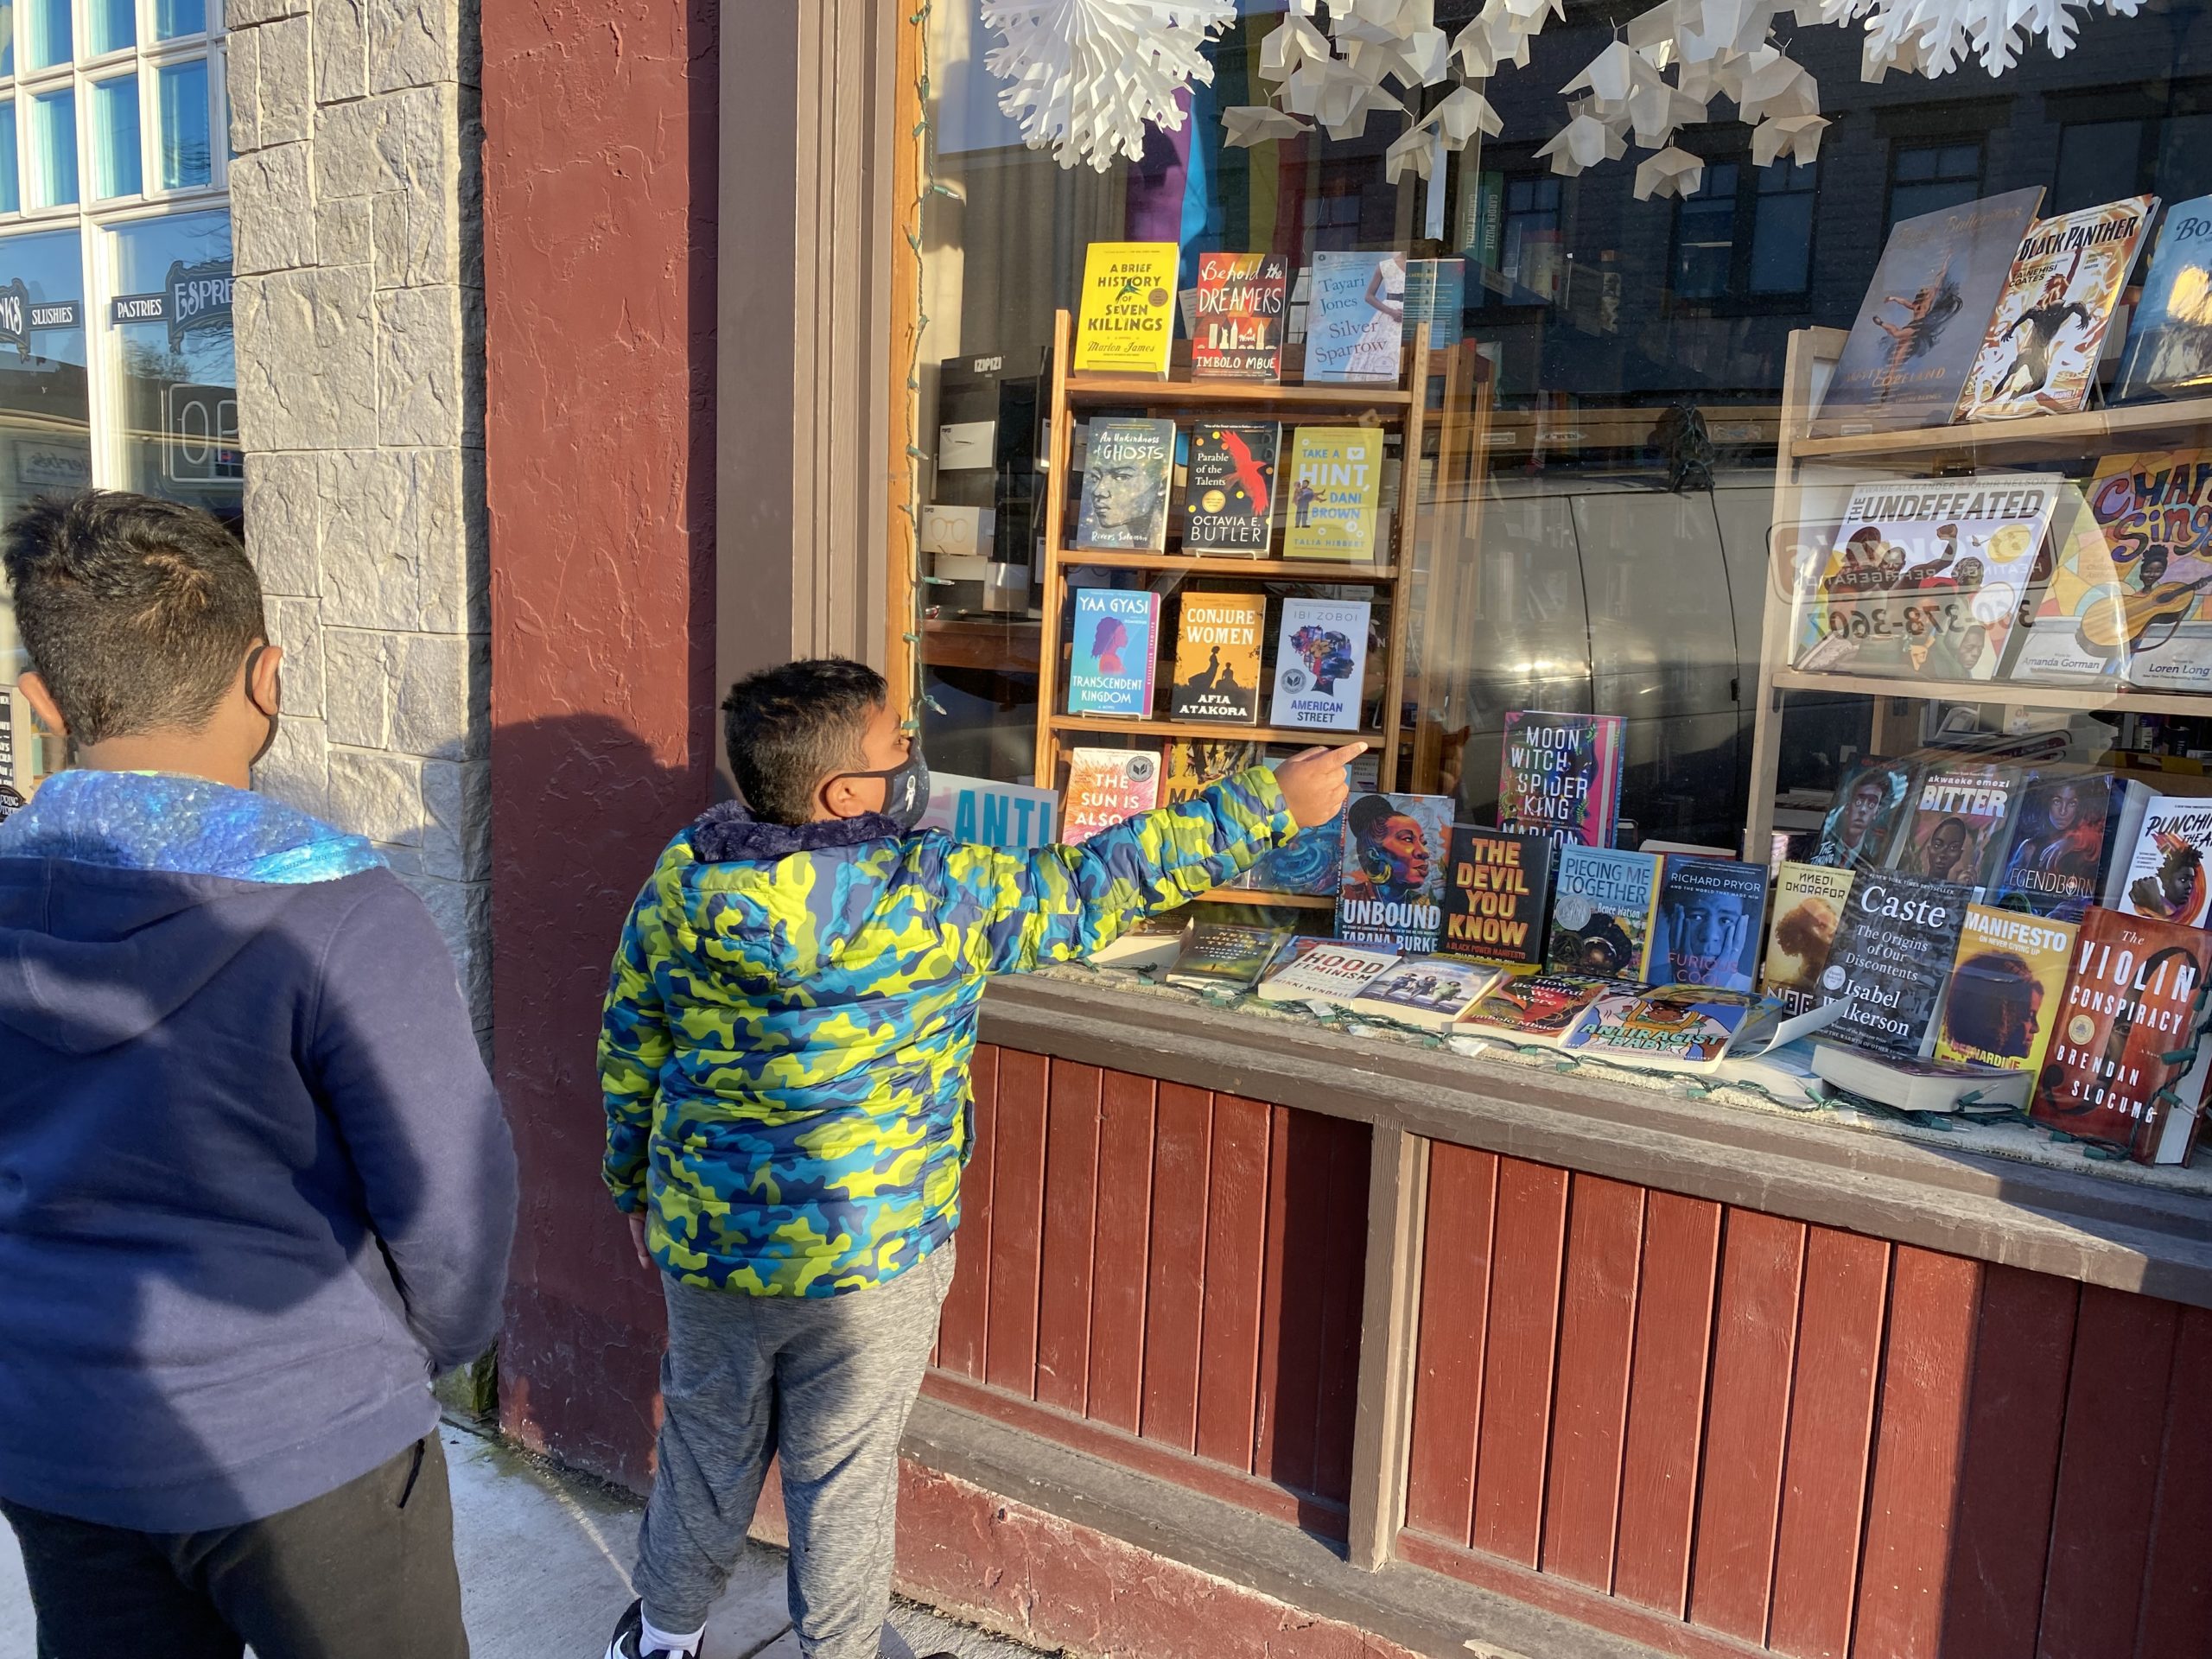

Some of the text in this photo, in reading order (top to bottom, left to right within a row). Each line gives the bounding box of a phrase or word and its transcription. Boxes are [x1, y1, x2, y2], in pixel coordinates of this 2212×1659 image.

[2018, 216, 2139, 262] BLACK PANTHER
[1110, 264, 1153, 273] A BRIEF
[1202, 257, 1282, 283] Behold the
[1097, 276, 1161, 287] HISTORY
[1319, 273, 1365, 295] Tayari
[2009, 274, 2045, 288] COATES
[117, 298, 162, 319] PASTRIES
[1198, 286, 1282, 315] DREAMERS
[1320, 297, 1358, 317] Jones
[32, 307, 73, 325] SLUSHIES
[1106, 304, 1147, 315] SEVEN
[1088, 318, 1163, 331] KILLINGS
[1329, 320, 1378, 339] Silver
[1087, 340, 1154, 353] Marlon James
[1315, 340, 1388, 366] Sparrow
[974, 356, 1002, 373] IZIPIZI
[1197, 356, 1276, 370] IMBOLO MBUE
[1099, 432, 1160, 443] An Unkindness
[1103, 444, 1164, 461] GHOSTS
[1197, 453, 1229, 462] Parable
[1302, 449, 1340, 458] TAKE A
[1196, 465, 1222, 474] of the
[1299, 463, 1370, 492] HINT,
[1195, 477, 1226, 486] Talents
[1896, 482, 1955, 493] ALEXANDER
[2004, 478, 2049, 487] NELSON
[1330, 493, 1362, 504] DANI
[1860, 489, 2044, 524] UNDEFEATED
[1312, 507, 1360, 519] BROWN
[1847, 498, 1866, 524] THE
[1192, 516, 1261, 527] OCTAVIA E.
[1191, 526, 1261, 542] BUTLER
[1080, 596, 1148, 614] YAA GYASI
[1187, 608, 1255, 625] CONJURE
[1294, 611, 1358, 622] IBI ZOBOI
[1186, 626, 1255, 645] WOMEN
[2023, 657, 2100, 670] Amanda Gorman
[2149, 664, 2179, 673] Loren
[2183, 664, 2211, 677] Long
[1073, 676, 1142, 690] TRANSCENDENT
[1081, 690, 1131, 703] KINGDOM
[1198, 694, 1230, 704] AFIA
[1179, 705, 1248, 716] ATAKORA
[1291, 700, 1343, 713] AMERICAN
[1297, 712, 1335, 723] STREET
[1526, 726, 1580, 750] MOON
[1511, 747, 1567, 772] WITCH
[1095, 774, 1129, 789] THE
[1517, 772, 1588, 799] SPIDER
[1081, 792, 1140, 810] SUN IS
[1524, 795, 1569, 820] KING
[1919, 785, 2008, 818] BITTER
[954, 789, 1052, 848] ANTI
[1074, 813, 1122, 827] ALSO
[2183, 833, 2203, 844] THE
[1471, 837, 1522, 868] THE
[1819, 841, 1835, 855] THE
[1456, 861, 1529, 895] DEVIL
[1566, 858, 1650, 886] PIECING ME
[1565, 874, 1647, 904] TOGETHER
[1671, 873, 1761, 892] RICHARD PRYOR
[1785, 881, 1846, 899] OKORAFOR
[1920, 883, 1955, 895] BESTSELLER
[1465, 889, 1516, 919] YOU
[1618, 905, 1641, 918] Watson
[1861, 886, 1946, 928] Caste
[1343, 899, 1441, 930] UNBOUND
[1447, 913, 1529, 948] KNOW
[1857, 925, 1929, 951] The Origins
[1964, 912, 2068, 952] MANIFESTO
[2122, 930, 2145, 945] The
[1207, 940, 1252, 949] TYSON
[1396, 935, 1439, 952] BURKE
[1452, 942, 1471, 951] BLACK
[1471, 945, 1492, 955] POWER
[1492, 947, 1526, 959] MANIFESTO
[1988, 938, 2007, 948] NEVER
[2008, 943, 2030, 954] GIVING
[1867, 944, 1908, 963] of Our
[1302, 952, 1384, 974] HOOD
[1669, 952, 1738, 974] FURIOUS
[1846, 952, 1919, 982] Discontents
[2079, 940, 2196, 1003] VIOLIN
[1294, 963, 1372, 982] FEMINISM
[1512, 982, 1585, 996] Beautiful
[1535, 978, 1568, 988] How
[1516, 994, 1557, 1006] Were
[1531, 990, 1554, 999] We
[1844, 979, 1901, 1008] Isabel
[2069, 985, 2183, 1035] CONSPIRACY
[1519, 1019, 1556, 1031] Mbue
[1579, 1023, 1726, 1046] ANTIRACIST
[1607, 1037, 1672, 1052] BABY
[2056, 1045, 2139, 1087] BRENDAN
[2071, 1080, 2153, 1123] SLOCUMB
